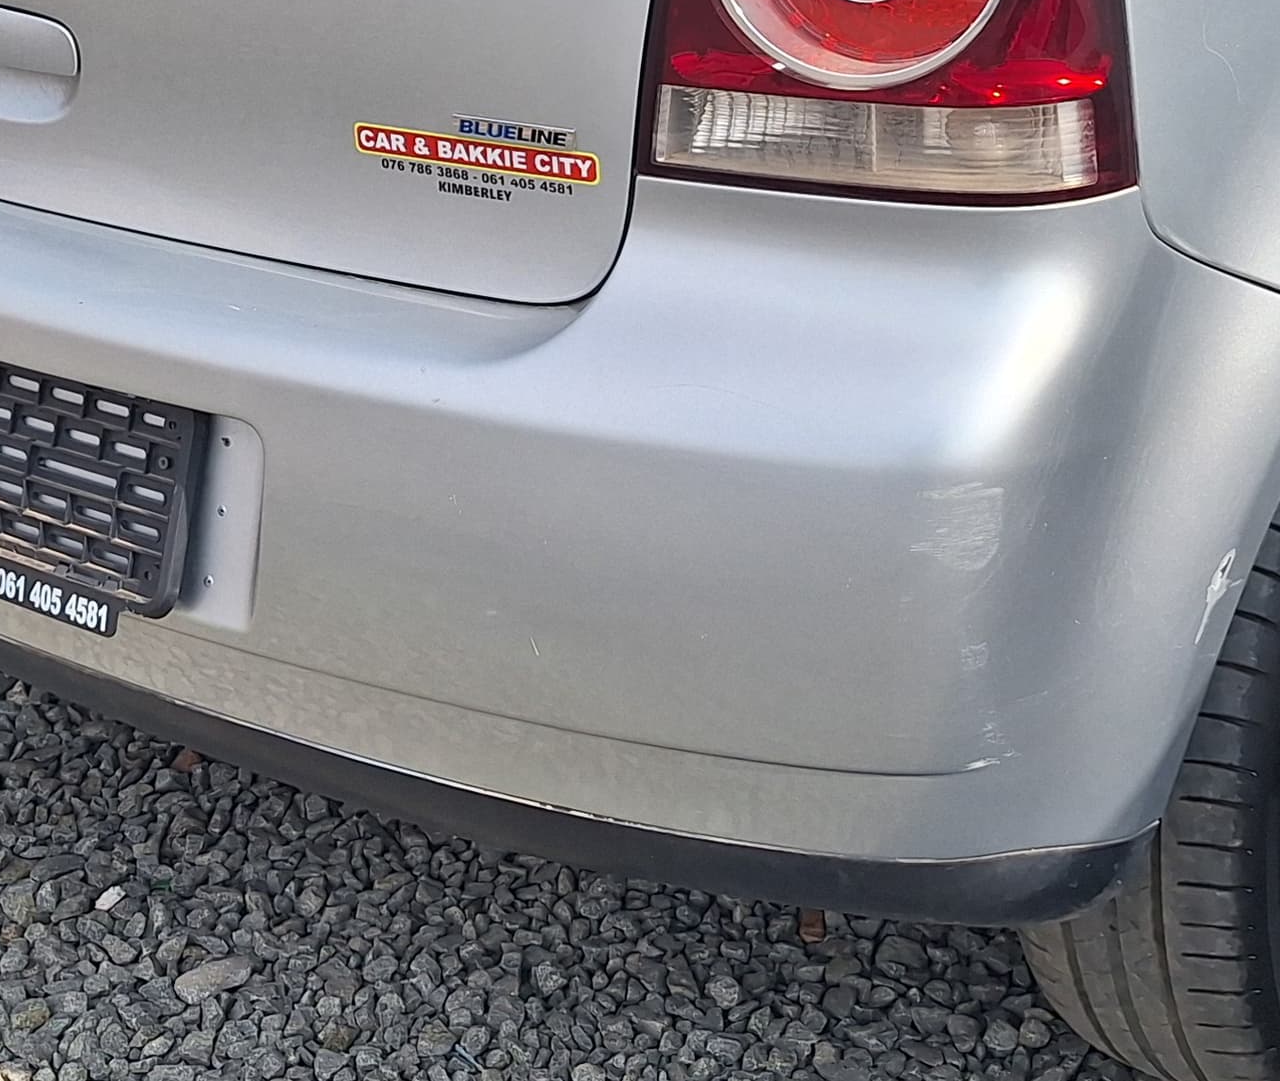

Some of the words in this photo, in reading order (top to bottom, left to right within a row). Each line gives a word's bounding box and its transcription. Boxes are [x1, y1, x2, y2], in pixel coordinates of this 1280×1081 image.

[459, 119, 568, 147] BLUELINE
[359, 129, 407, 153] CAR
[413, 136, 431, 156] &
[437, 140, 528, 170] BAKKIE
[535, 154, 594, 178] CITY
[381, 158, 405, 172] 076
[409, 162, 432, 175] 786
[437, 166, 469, 181] 3868
[482, 172, 505, 186] 061
[510, 176, 535, 191] 405
[540, 181, 573, 195] 4581
[439, 180, 512, 202] KIMBERLEY
[29, 581, 62, 616] 405
[65, 594, 108, 632] 4581
